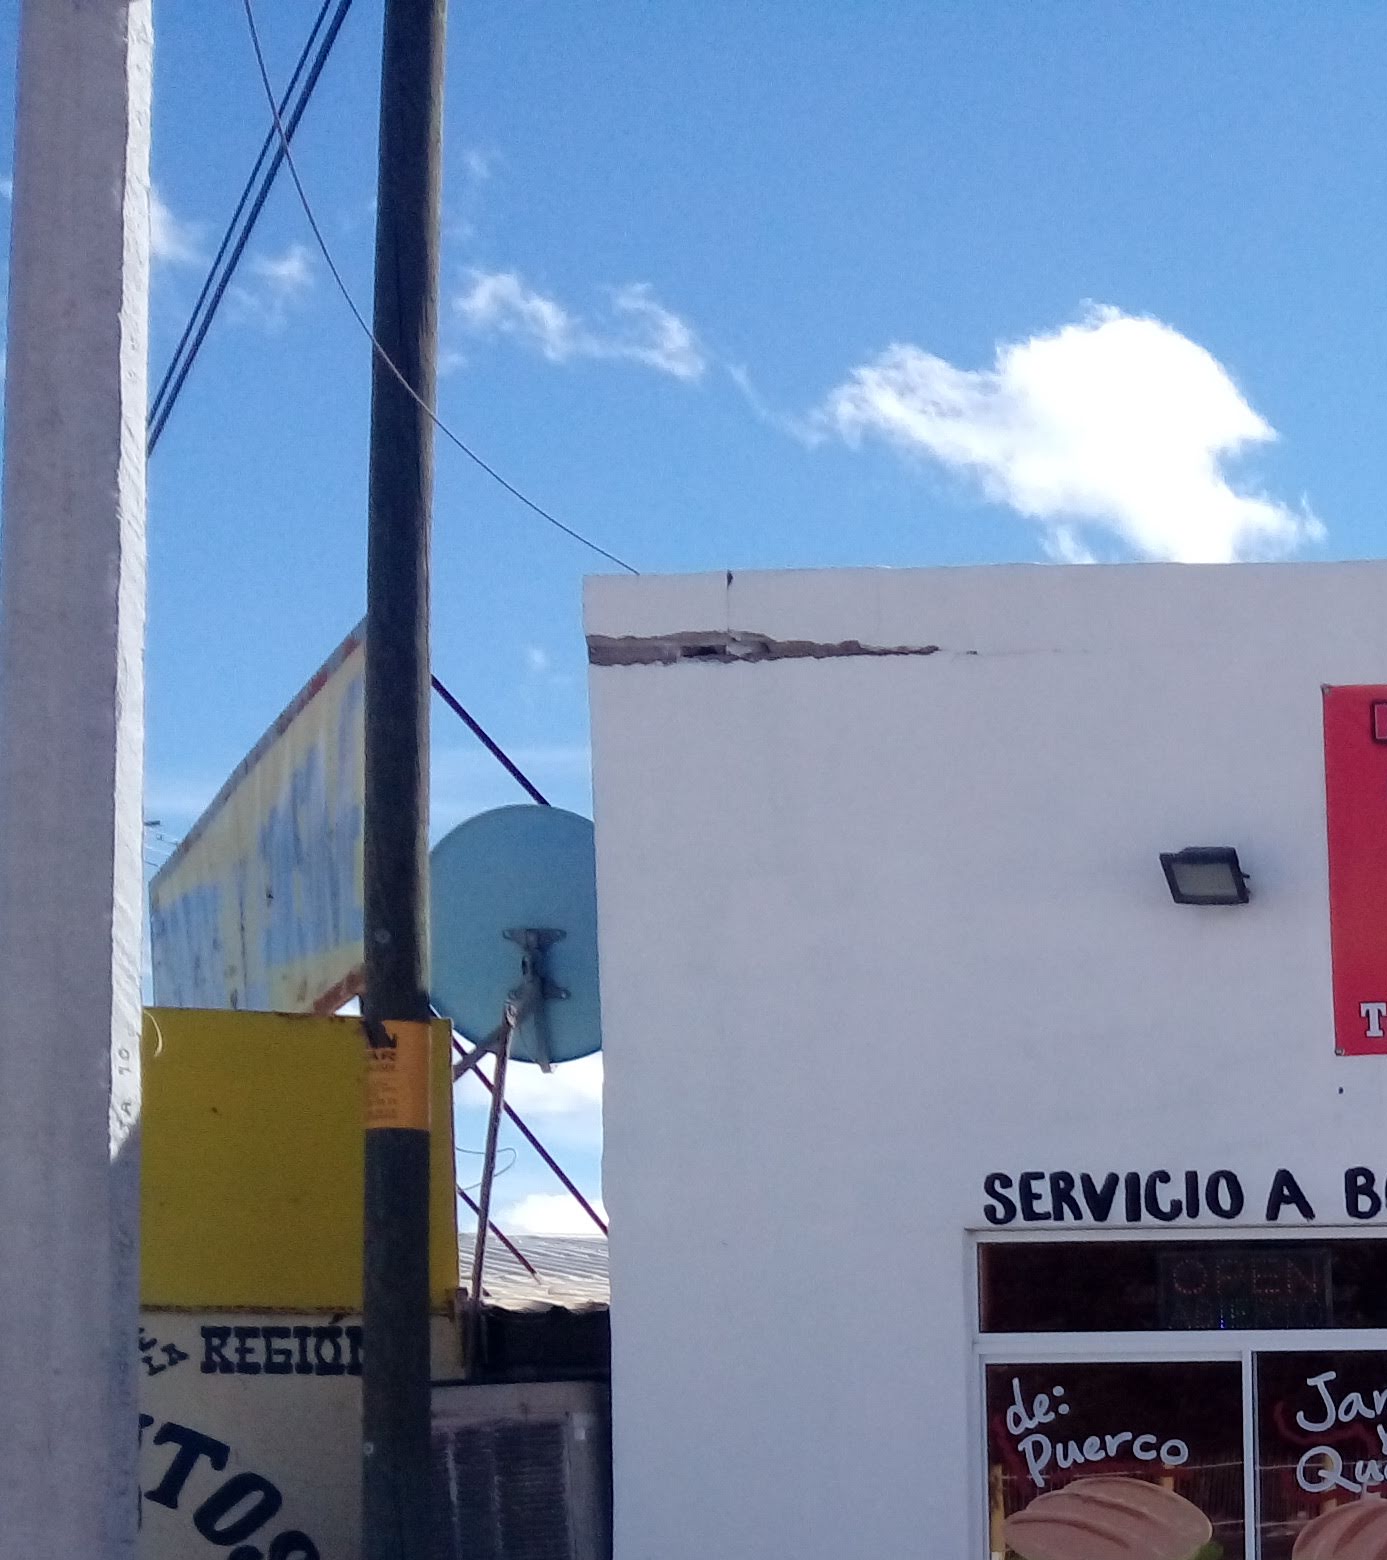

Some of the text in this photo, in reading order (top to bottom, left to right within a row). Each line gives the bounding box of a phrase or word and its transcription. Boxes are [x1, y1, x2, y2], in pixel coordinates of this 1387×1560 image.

[983, 1168, 1245, 1225] SERVICIO
[1265, 1168, 1316, 1222] A
[1171, 1257, 1319, 1296] OPEN
[1006, 1377, 1070, 1436] de:
[1018, 1431, 1188, 1487] Puerco
